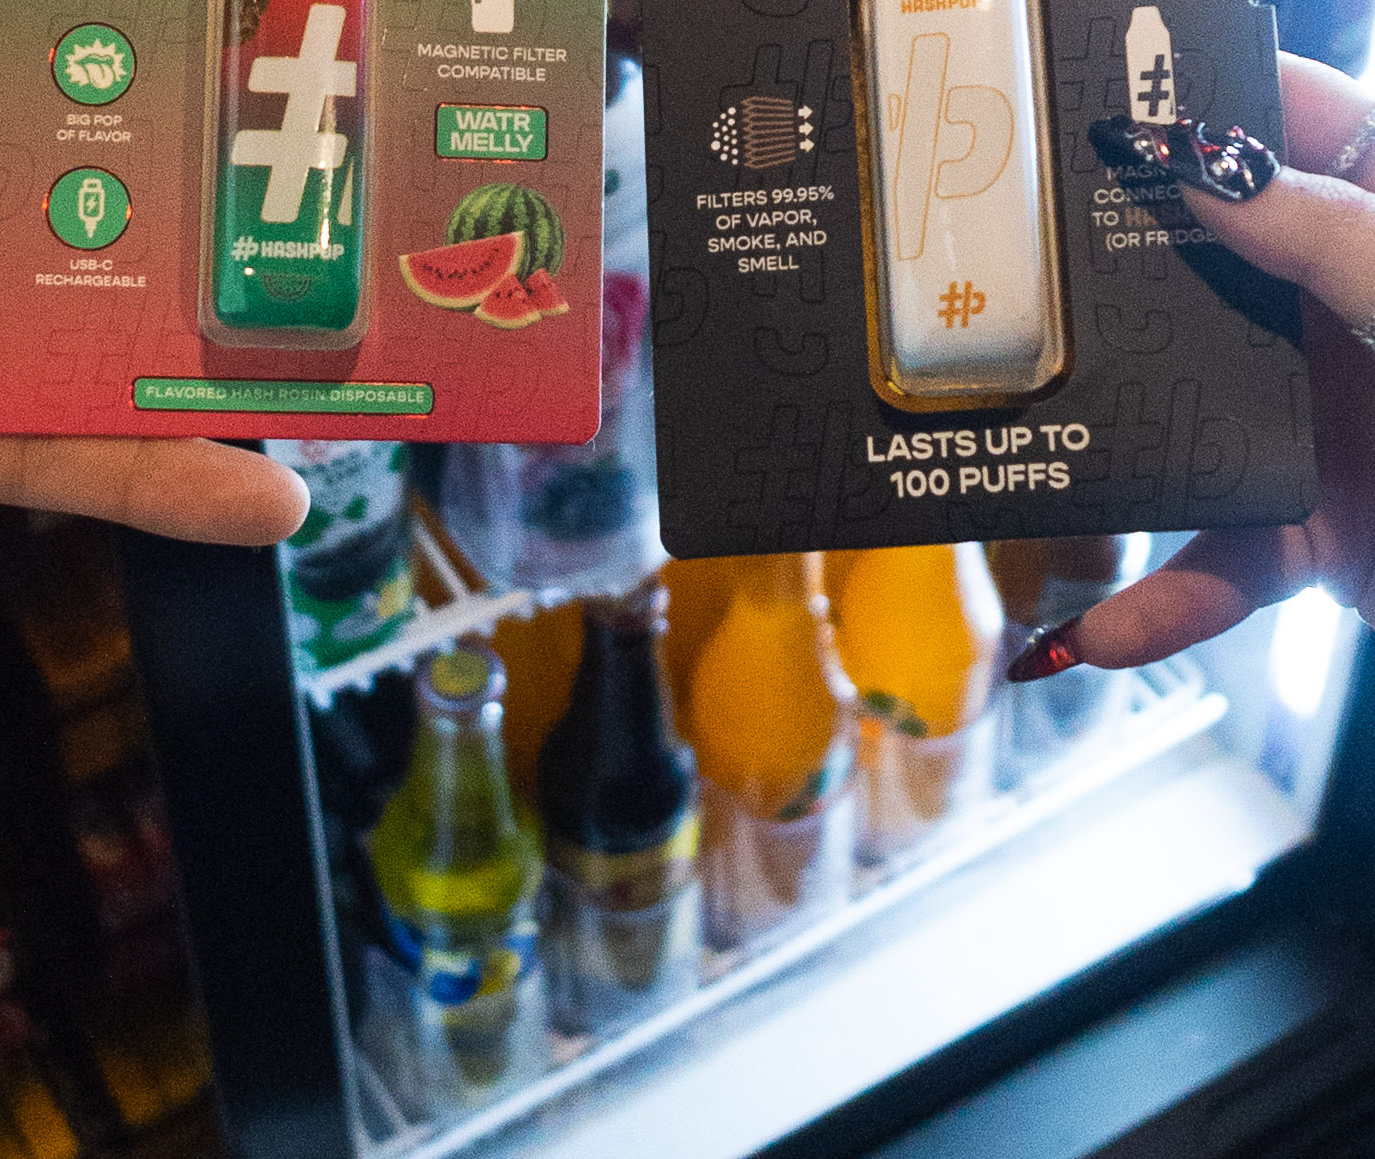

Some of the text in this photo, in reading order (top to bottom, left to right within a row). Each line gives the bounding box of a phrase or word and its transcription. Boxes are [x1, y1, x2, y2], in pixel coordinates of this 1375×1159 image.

[417, 43, 568, 63] MAGNETIC FILTER
[437, 64, 547, 82] COMPATIBLE
[66, 113, 123, 127] BIG POP
[455, 110, 531, 132] WATR
[56, 129, 132, 143] OF FLAVOR
[450, 131, 533, 153] MELLY
[696, 184, 835, 210] FILTERS 99.95%
[715, 208, 818, 230] OF VAPOR,
[1091, 210, 1119, 228] TO
[707, 229, 828, 253] SMOKE, AND
[1105, 231, 1141, 253] (OR
[69, 258, 113, 271] USB-C
[737, 254, 800, 274] SMELL
[35, 273, 147, 288] RECHARGEABLE
[145, 386, 426, 403] FLAVORED HASH ROSIN DISPOSABLE
[865, 422, 1091, 463] LASTS UP TO
[889, 461, 1071, 499] 100 PUFFS
